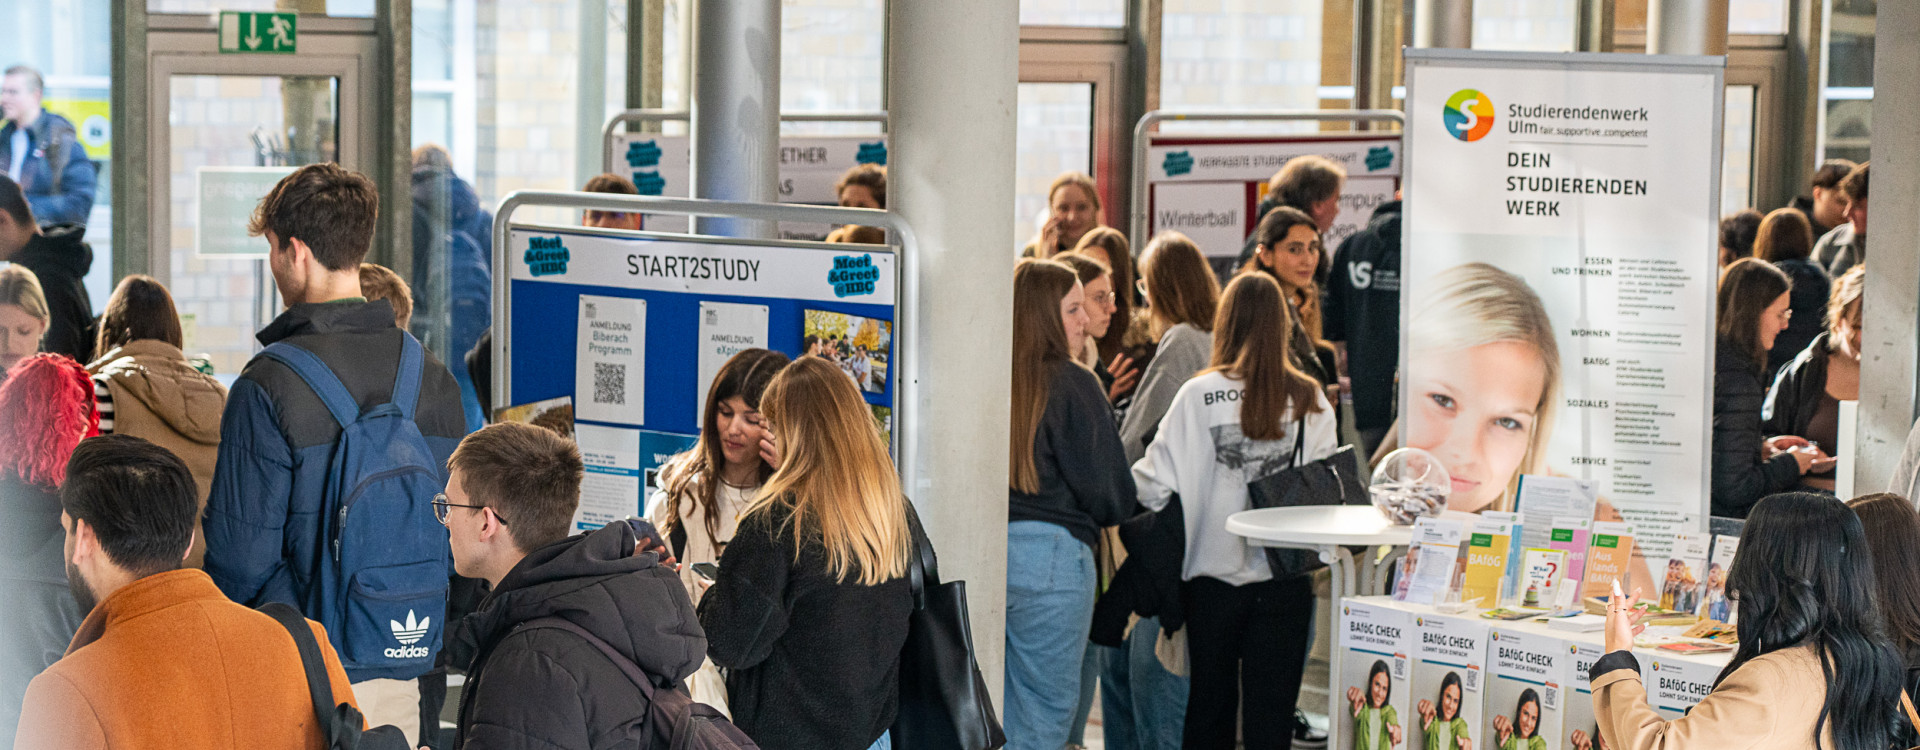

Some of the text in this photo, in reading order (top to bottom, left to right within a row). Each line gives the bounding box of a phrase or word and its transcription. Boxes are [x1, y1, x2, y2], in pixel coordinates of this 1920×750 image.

[1509, 103, 1649, 121] Studierendenwerk
[1508, 119, 1539, 135] Ulm
[781, 147, 827, 164] ETHER
[1507, 152, 1552, 168] DEIN
[1506, 176, 1647, 196] STUDIERENDEN
[1339, 193, 1386, 213] mpus
[1506, 200, 1561, 217] WERK
[1159, 210, 1237, 228] Winterball
[530, 238, 562, 250] Meet
[526, 249, 569, 263] &Greet
[835, 257, 869, 270] Meet
[627, 254, 760, 281] START2STUDY
[1552, 267, 1571, 275] UND
[1574, 268, 1613, 276] TRINKEN
[830, 268, 878, 283] &Greet
[835, 281, 873, 297] @HBC
[589, 321, 632, 331] ANMELDUNG
[1571, 329, 1611, 338] WOHNEN
[592, 331, 628, 344] Biberach
[711, 334, 754, 345] ANMELDUNG
[589, 343, 632, 357] Programm
[1567, 399, 1609, 409] SOZIALES
[1571, 456, 1607, 466] SERVICE
[1469, 553, 1502, 568] BAföG
[1595, 551, 1612, 562] Aus
[1350, 621, 1401, 639] BAföG CHECK
[1422, 632, 1475, 651] BAföG CHECK
[384, 645, 429, 659] adidas
[1498, 647, 1553, 668] BAföG CHECK
[1659, 677, 1712, 695] BAföG CHEC
